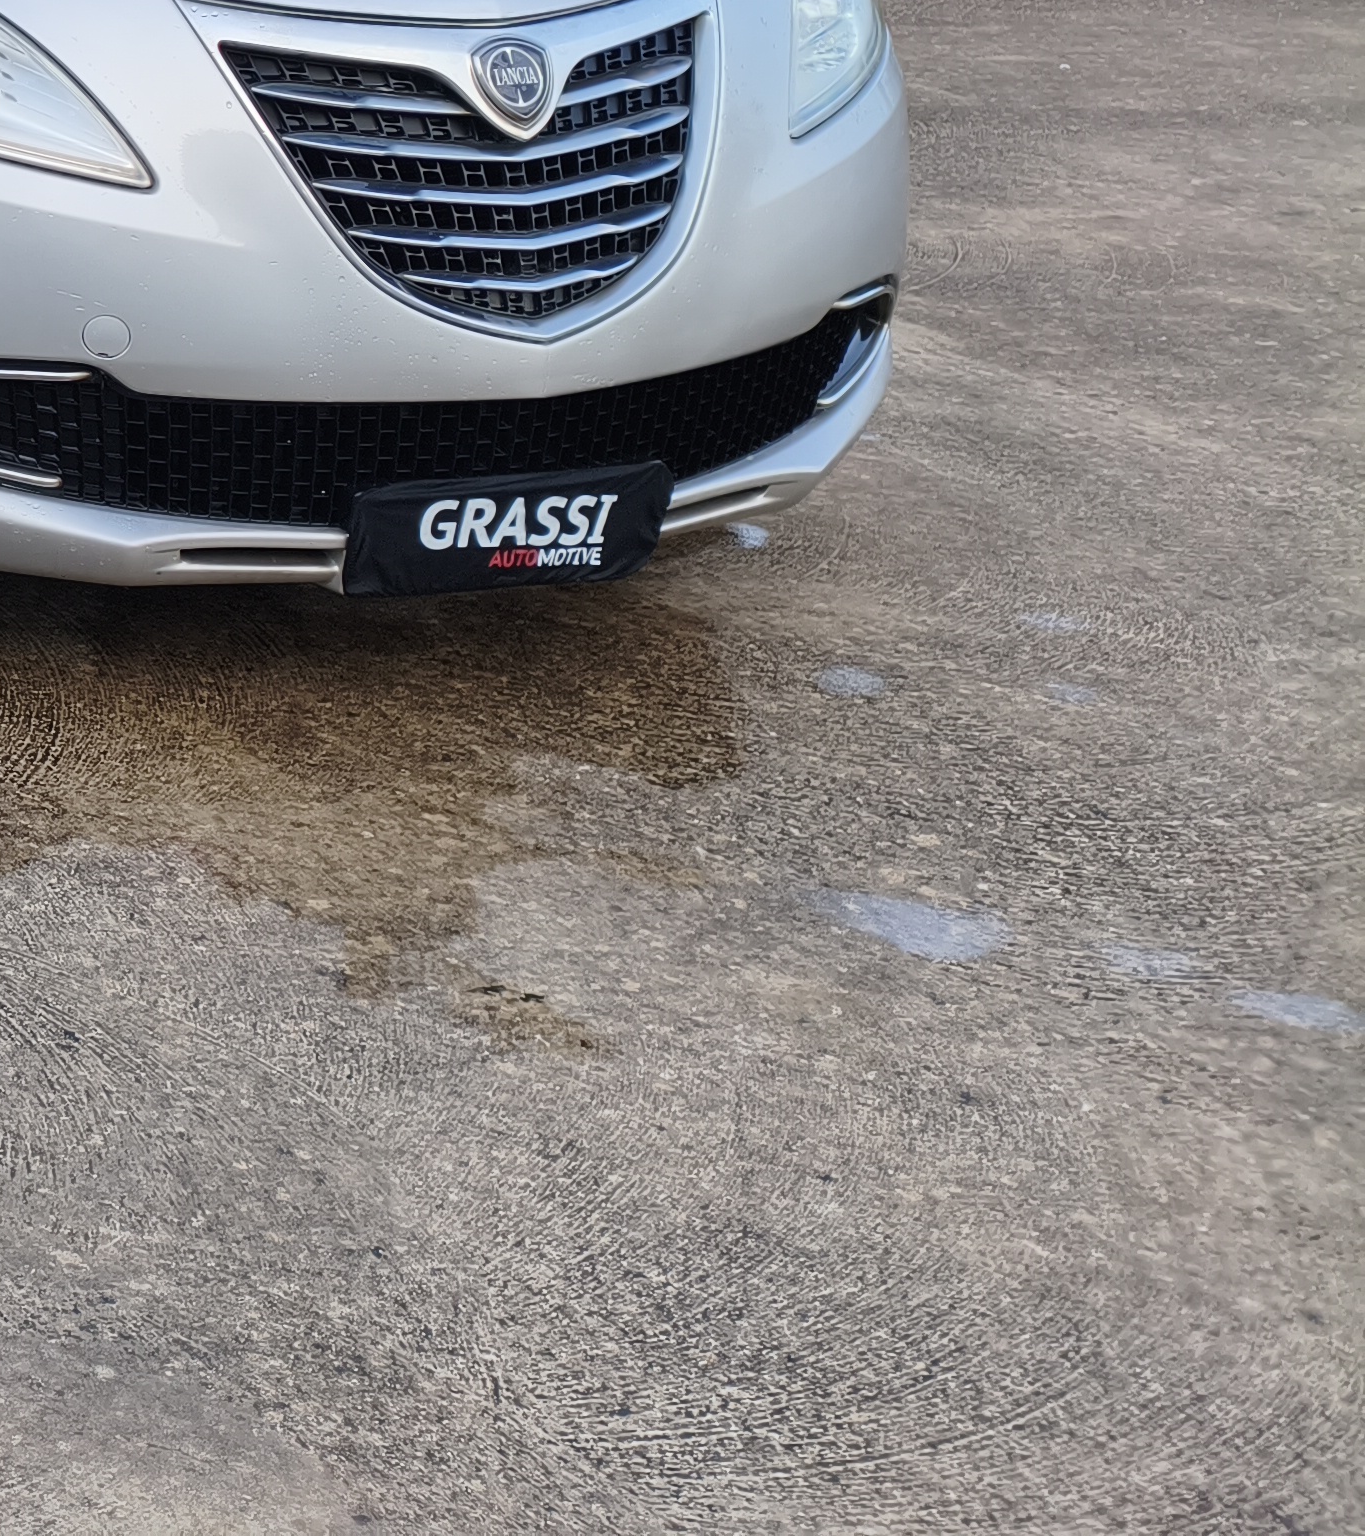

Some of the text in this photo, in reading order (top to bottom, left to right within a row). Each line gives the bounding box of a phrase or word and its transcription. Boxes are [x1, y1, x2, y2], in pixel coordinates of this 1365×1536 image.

[493, 67, 538, 85] LANCIA
[419, 494, 619, 551] GRASSI
[487, 547, 603, 569] AUTOMOTIVE
